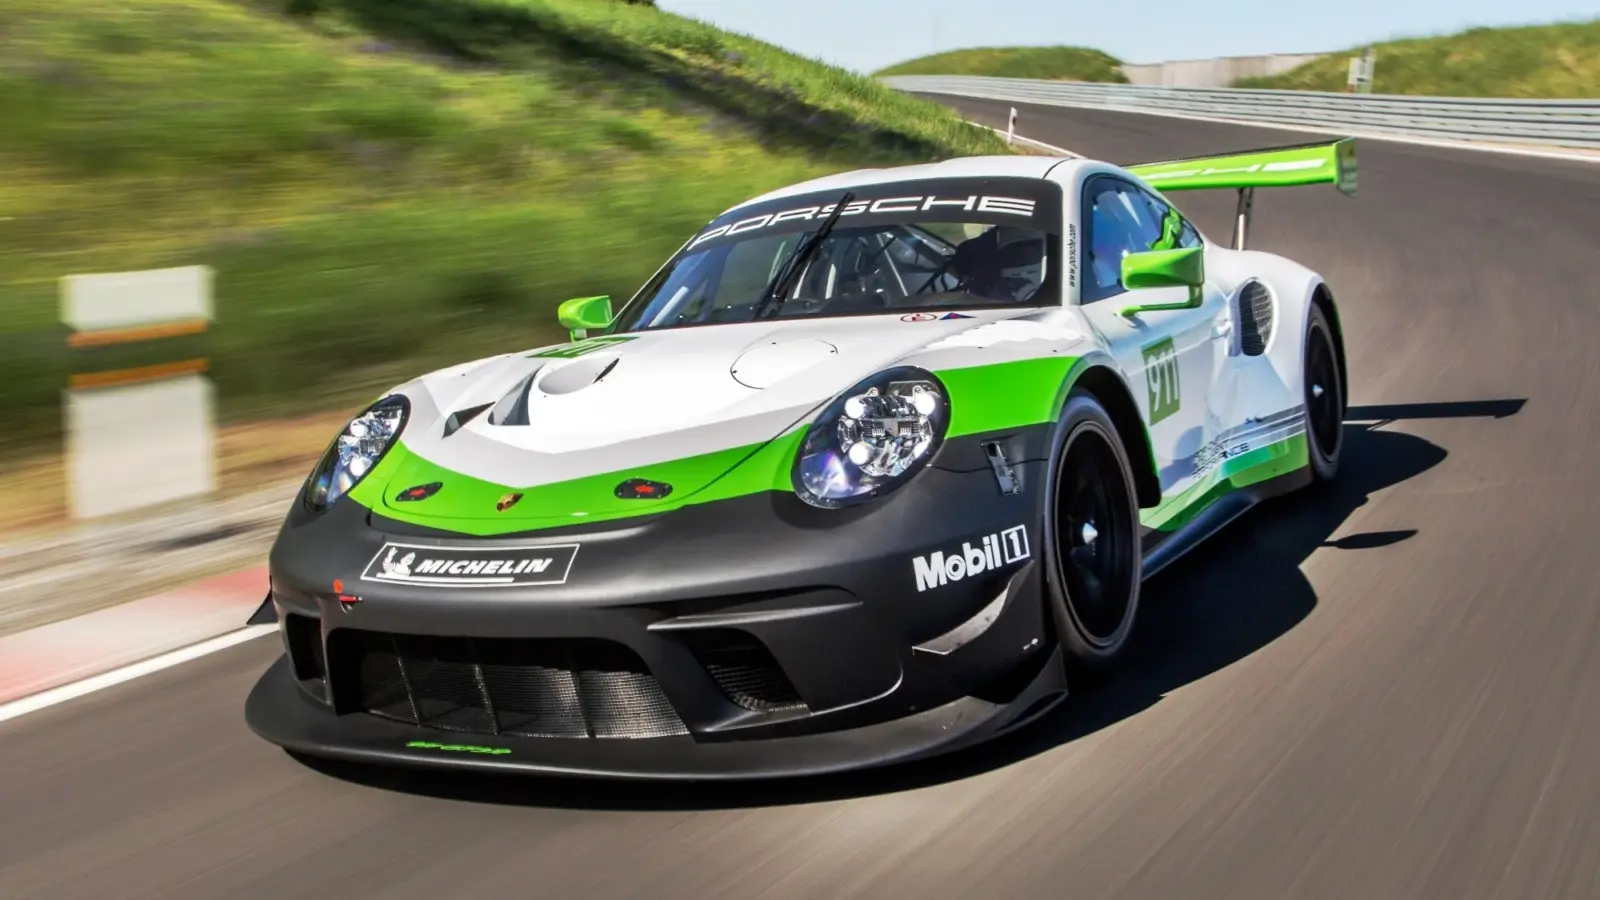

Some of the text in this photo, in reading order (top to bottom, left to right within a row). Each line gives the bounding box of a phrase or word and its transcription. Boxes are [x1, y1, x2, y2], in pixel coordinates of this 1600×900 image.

[687, 195, 1036, 250] PORSCHE
[1147, 346, 1179, 412] 911
[415, 558, 553, 575] MICHELIN
[912, 533, 1003, 592] Mobil
